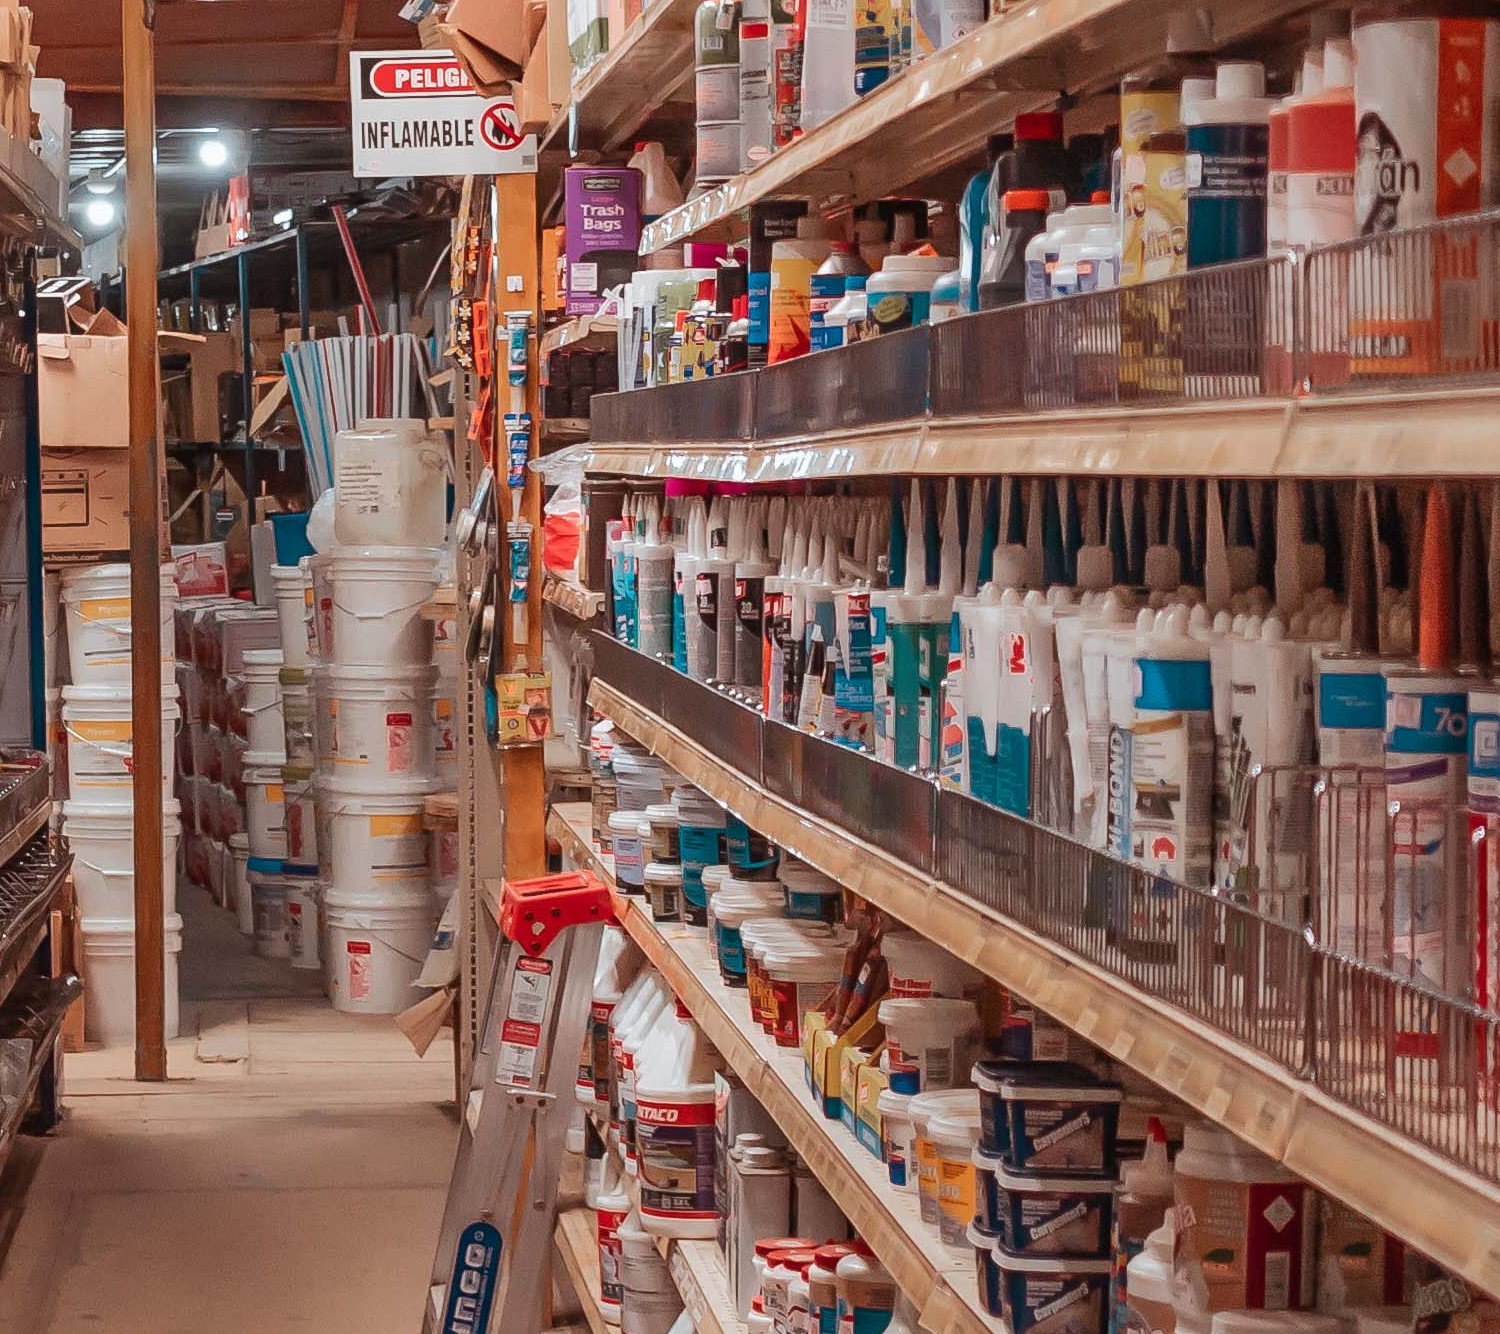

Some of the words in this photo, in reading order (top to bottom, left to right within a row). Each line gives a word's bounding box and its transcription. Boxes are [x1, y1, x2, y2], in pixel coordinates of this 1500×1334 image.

[360, 119, 475, 150] INFLAMABLE
[580, 203, 625, 217] Trash
[583, 218, 623, 233] Bags
